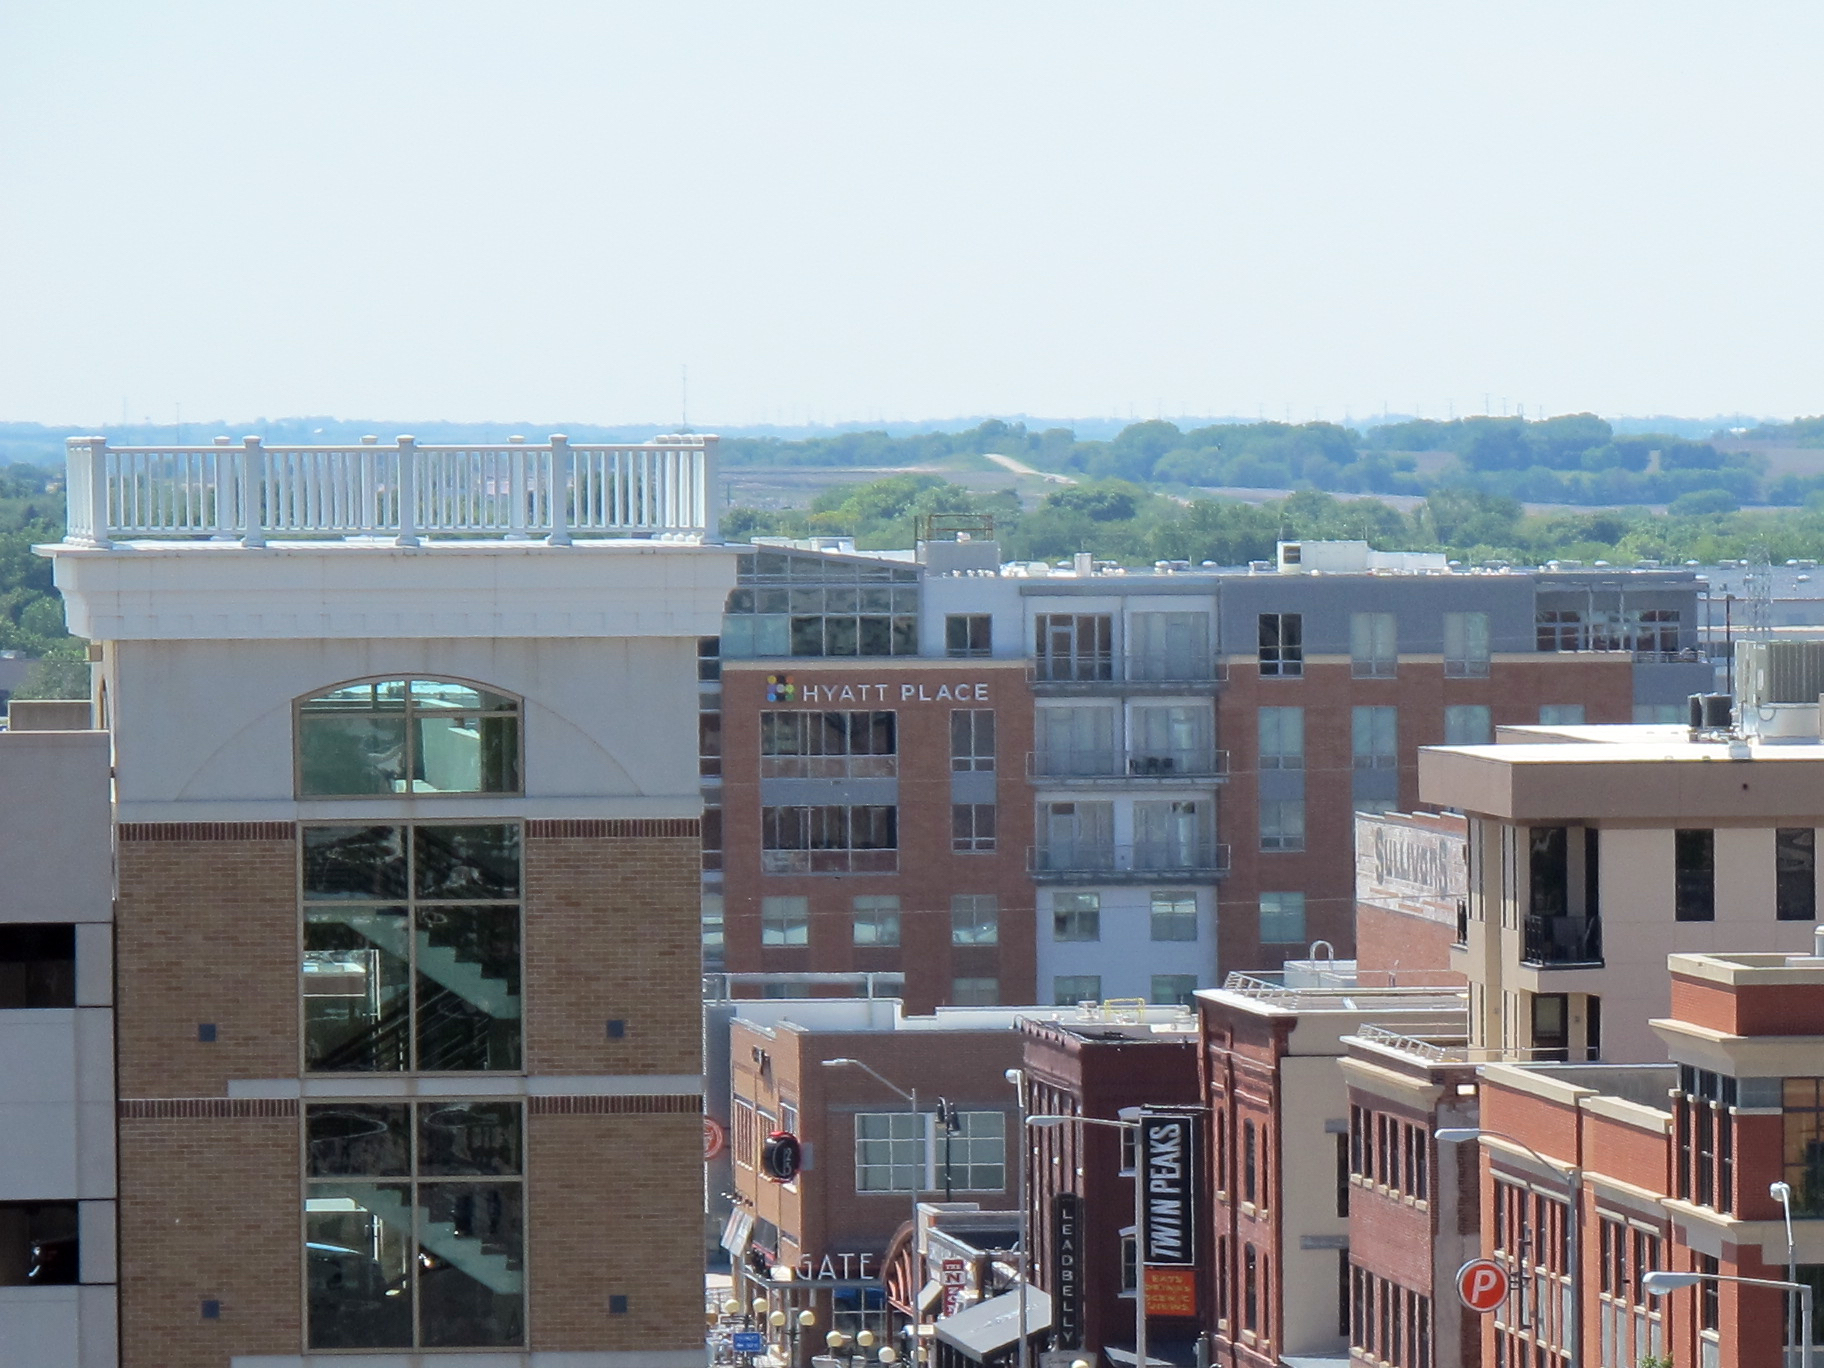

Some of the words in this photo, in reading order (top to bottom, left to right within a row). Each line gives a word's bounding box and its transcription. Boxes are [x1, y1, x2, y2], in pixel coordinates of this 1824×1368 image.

[803, 684, 888, 702] HYATT
[901, 684, 989, 701] PLACE
[1149, 1123, 1182, 1194] PEAKS
[1150, 1199, 1182, 1258] TWIN
[795, 1253, 874, 1280] GATE
[944, 1272, 961, 1283] N
[1061, 1208, 1074, 1342] LEADBELLY
[1471, 1269, 1497, 1304] P
